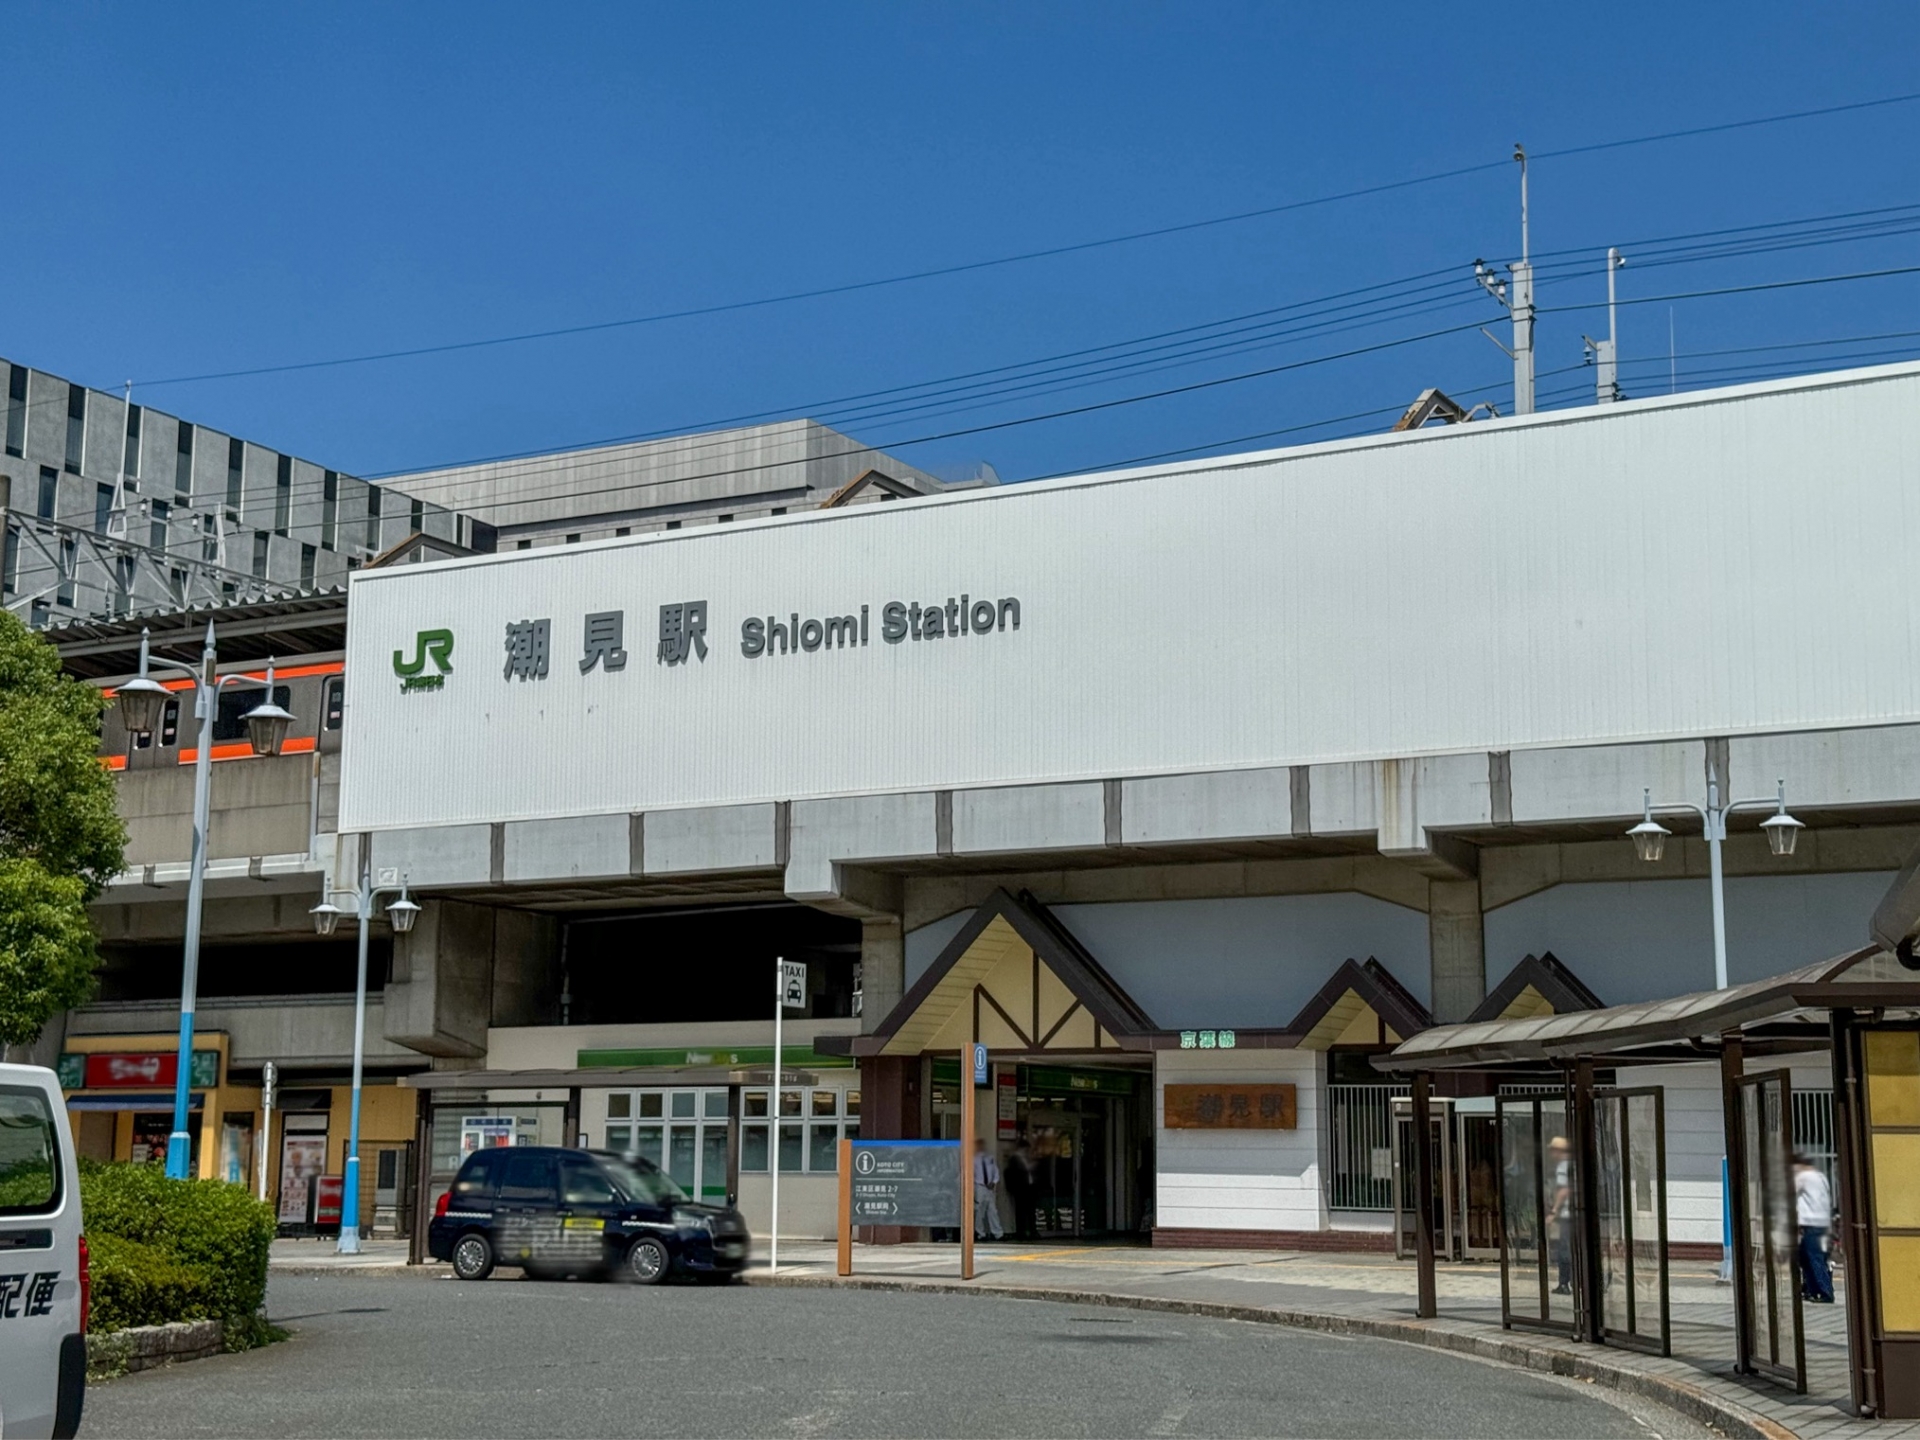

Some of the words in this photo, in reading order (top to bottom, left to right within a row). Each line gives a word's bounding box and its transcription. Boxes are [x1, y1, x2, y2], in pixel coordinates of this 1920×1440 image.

[393, 628, 454, 677] JR
[503, 600, 708, 683] 潮見駅
[740, 604, 869, 659] Shiomi
[881, 594, 1021, 645] Station
[785, 965, 805, 978] TAXI
[1180, 1030, 1236, 1049] 京葉線
